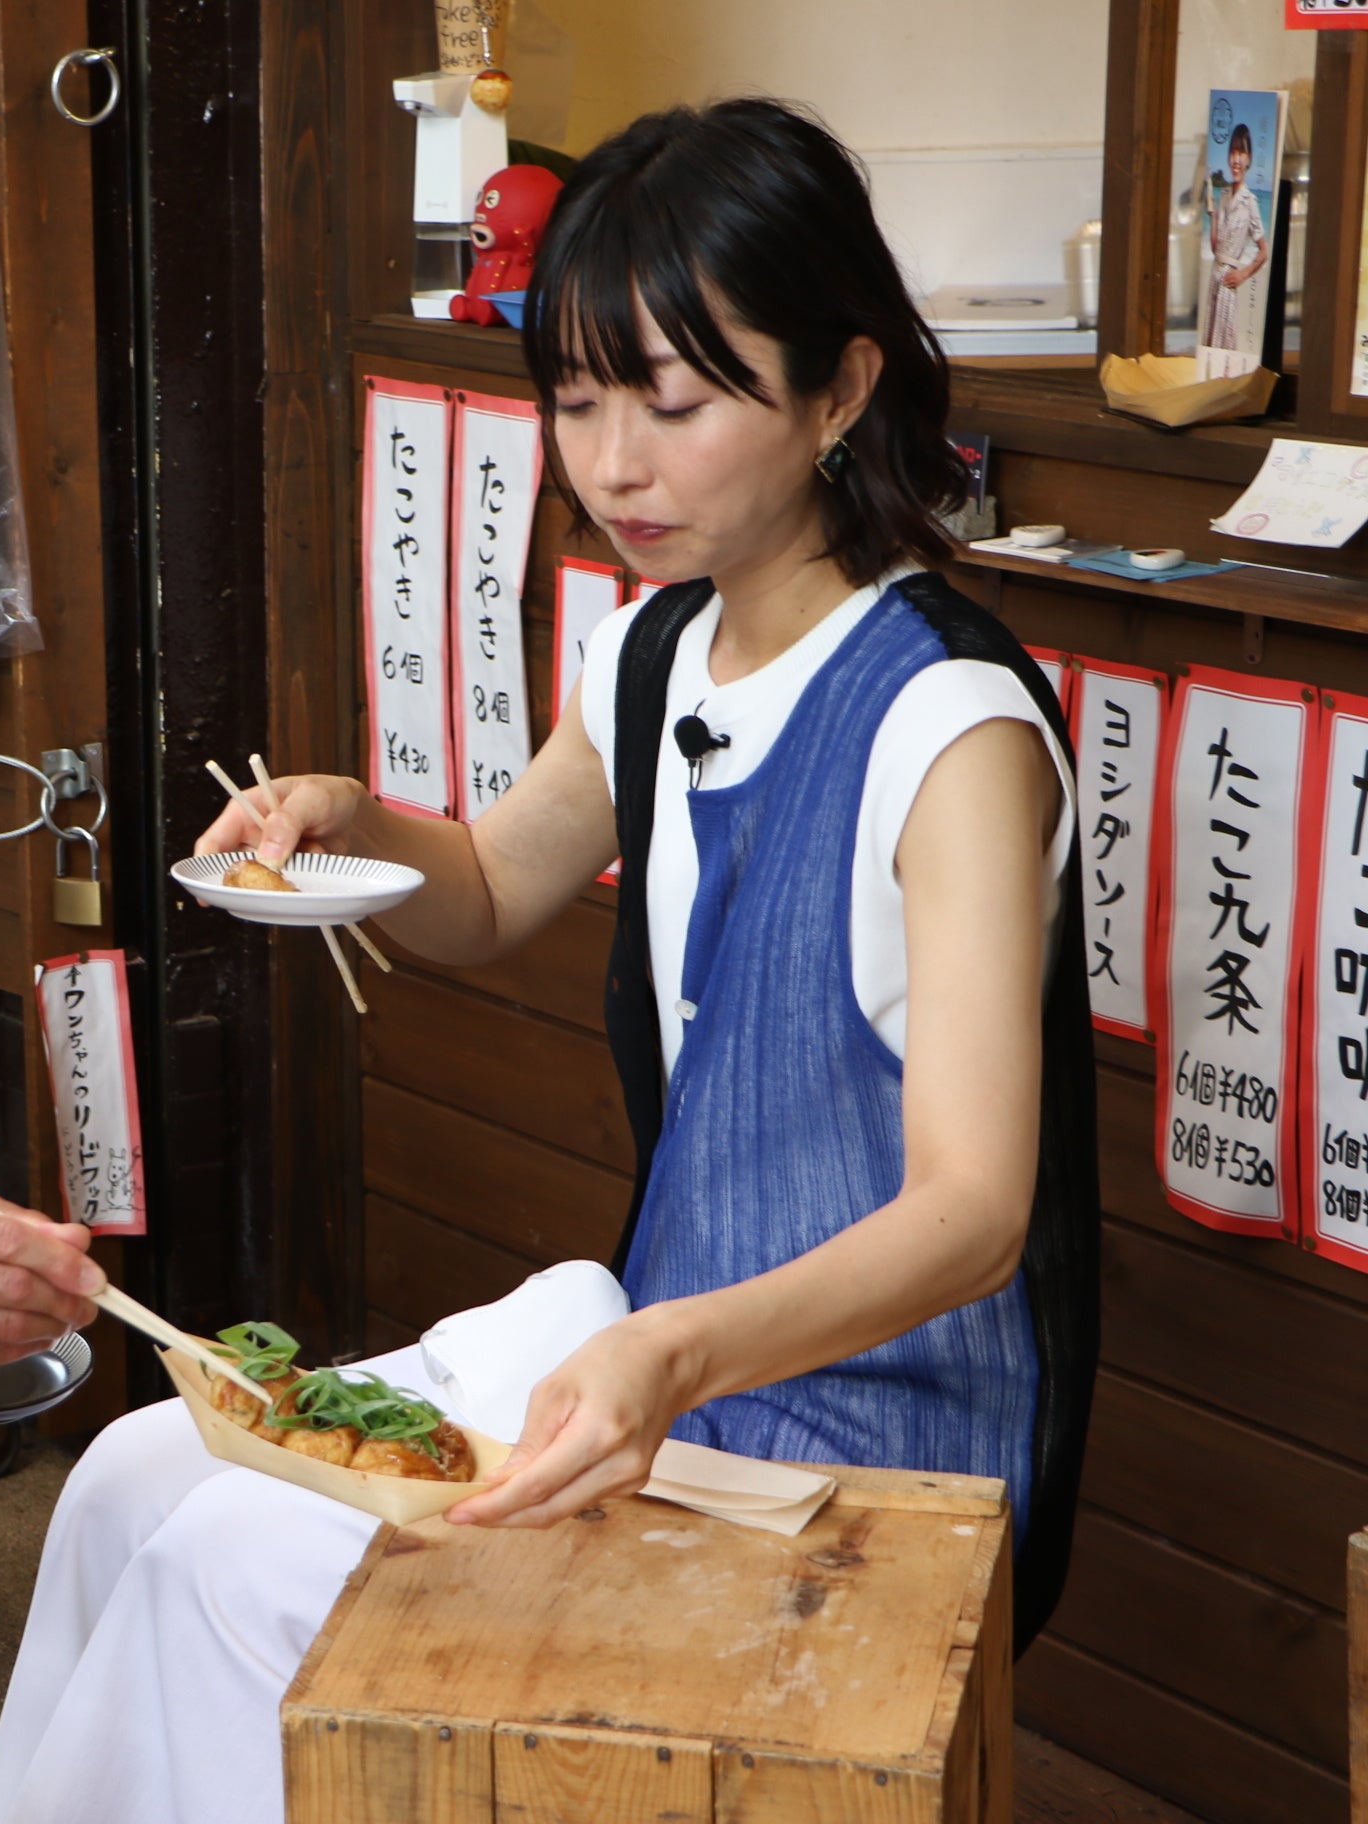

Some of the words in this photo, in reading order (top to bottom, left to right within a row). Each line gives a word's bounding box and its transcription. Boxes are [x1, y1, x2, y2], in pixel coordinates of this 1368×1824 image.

[390, 426, 419, 620] たこやき
[475, 455, 505, 661] たこやき
[382, 645, 424, 685] 6個
[384, 728, 431, 775] ¥430
[473, 684, 511, 725] 8個
[1088, 699, 1132, 987] ヨシダソース
[1203, 727, 1271, 1036] たこ九条
